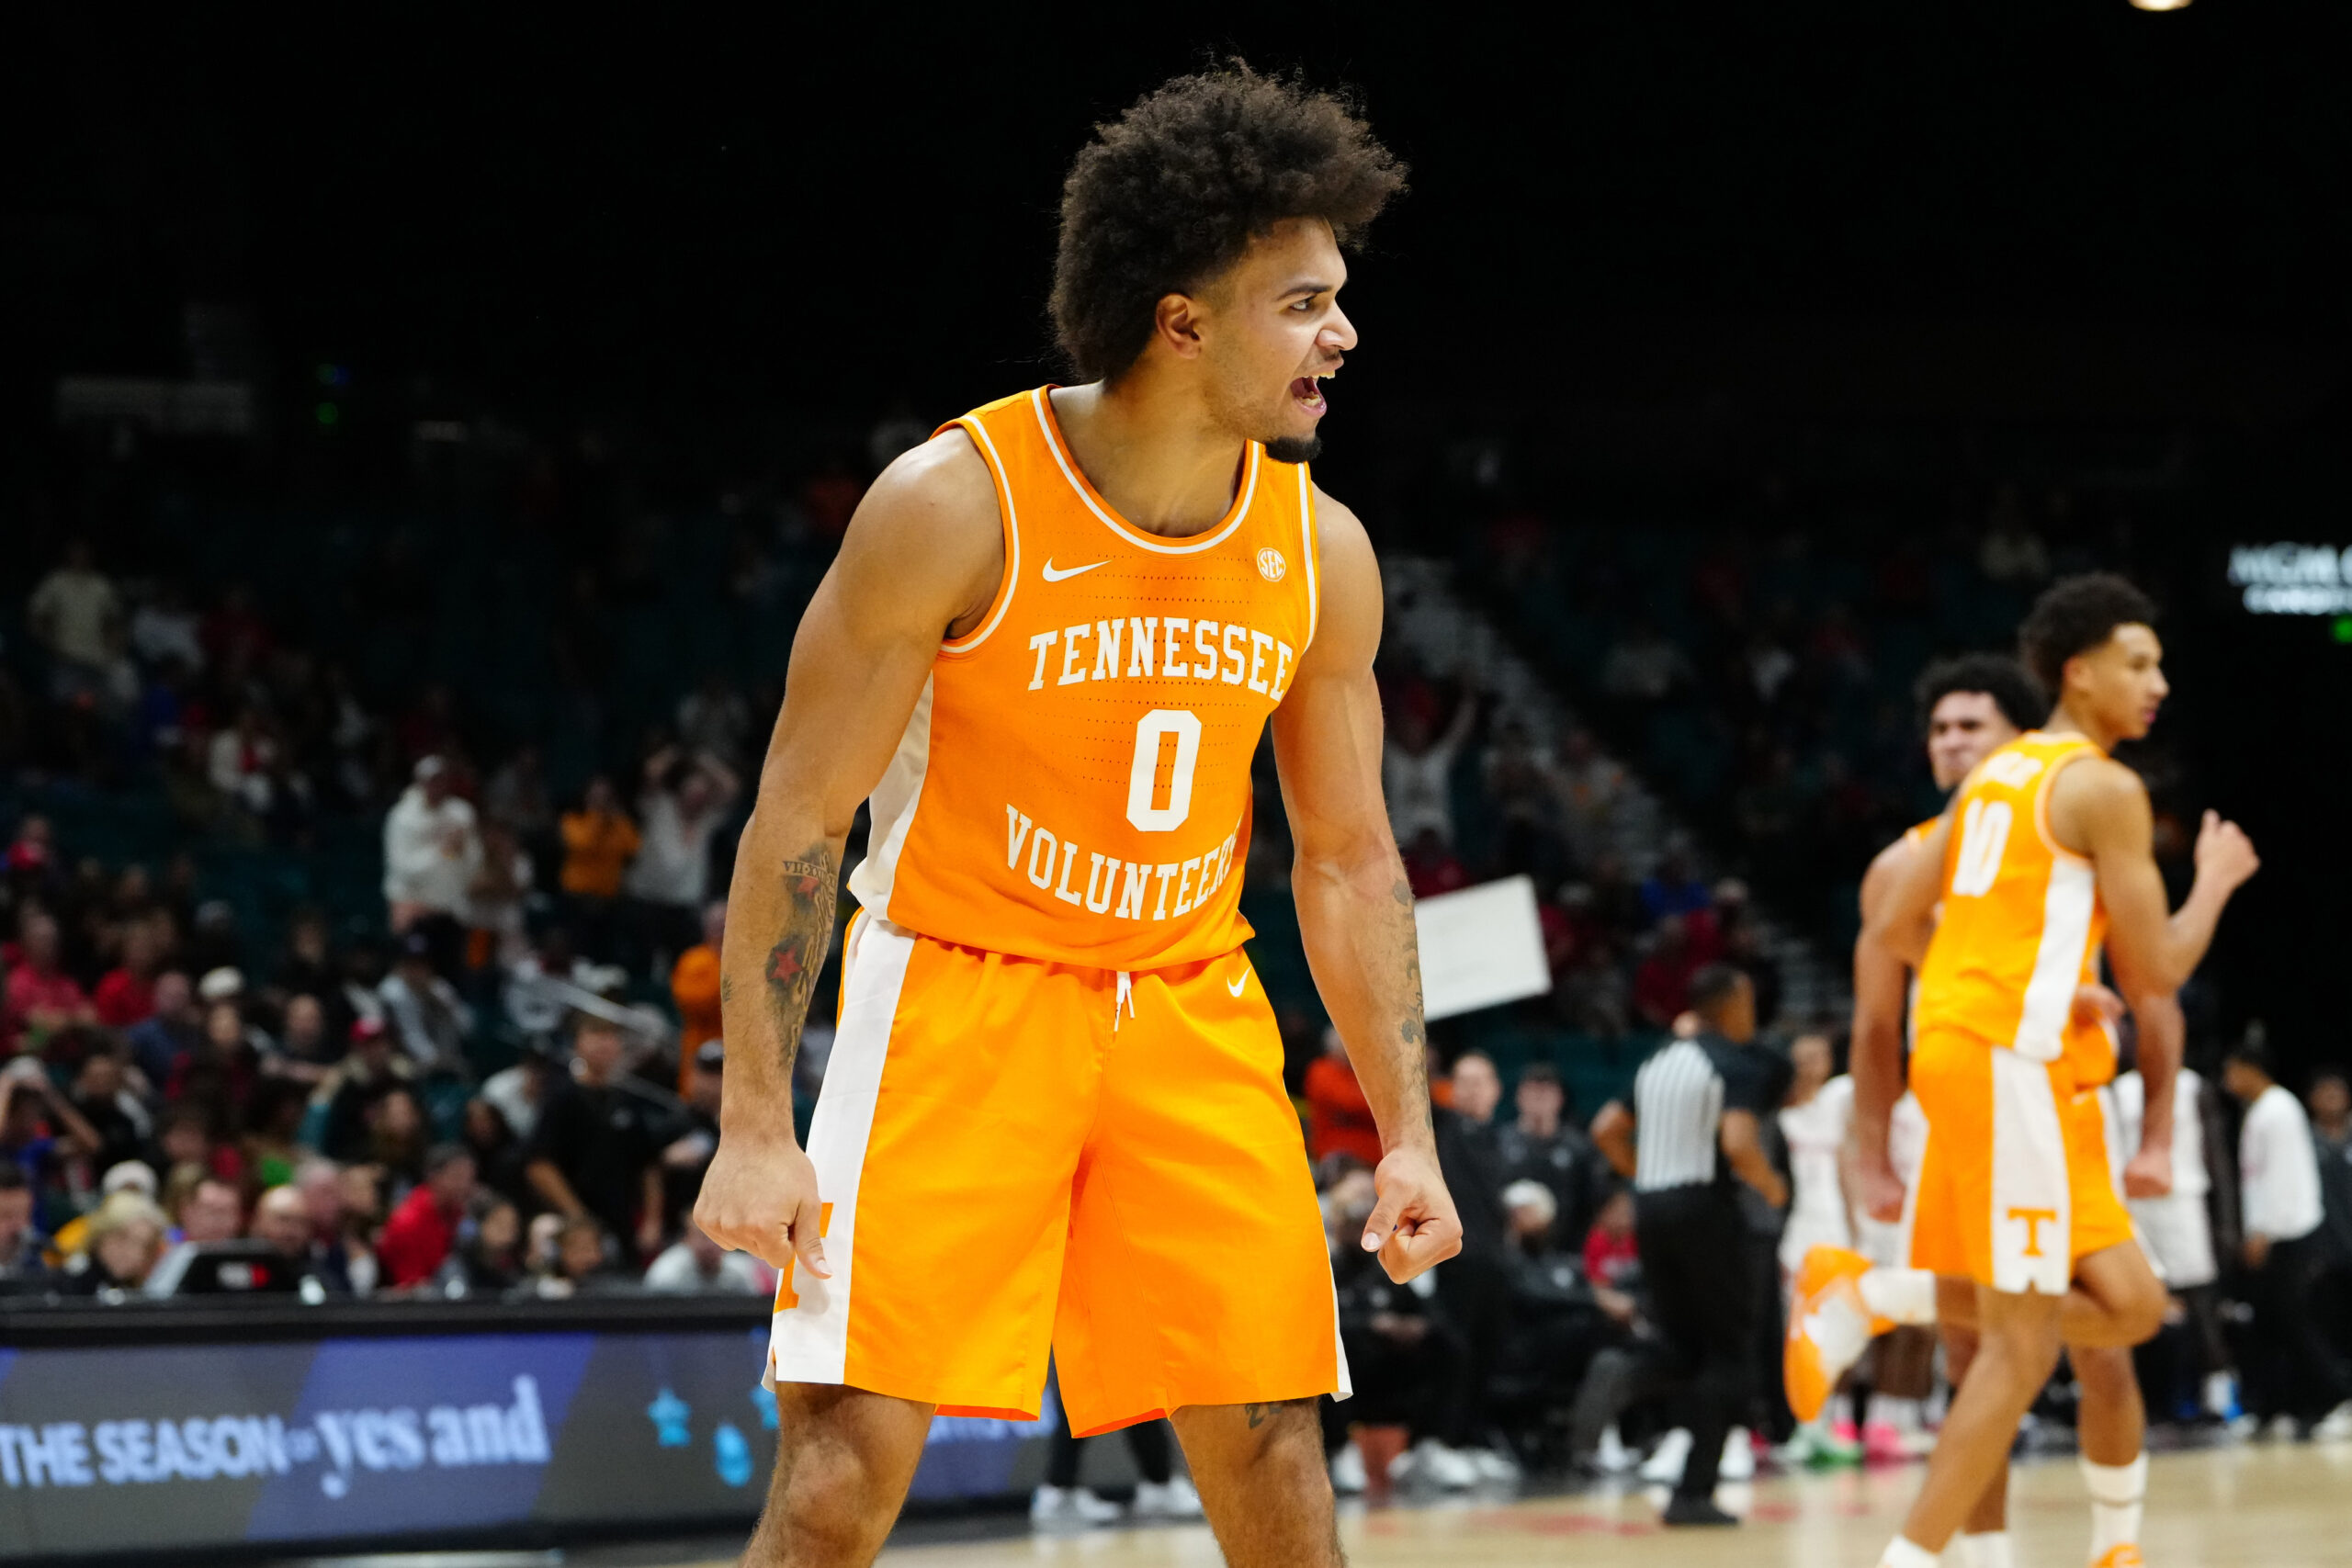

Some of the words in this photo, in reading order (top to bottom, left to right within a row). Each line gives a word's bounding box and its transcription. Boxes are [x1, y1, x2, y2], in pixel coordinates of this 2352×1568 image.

[1259, 549, 1284, 579] SEC
[1027, 616, 1293, 703] TENNESSEE
[1125, 708, 1202, 832] 0
[1951, 796, 2013, 897] 10
[2007, 1207, 2057, 1257] T
[94, 1415, 290, 1484] SEASON
[314, 1406, 426, 1499] yes
[427, 1373, 551, 1466] and
